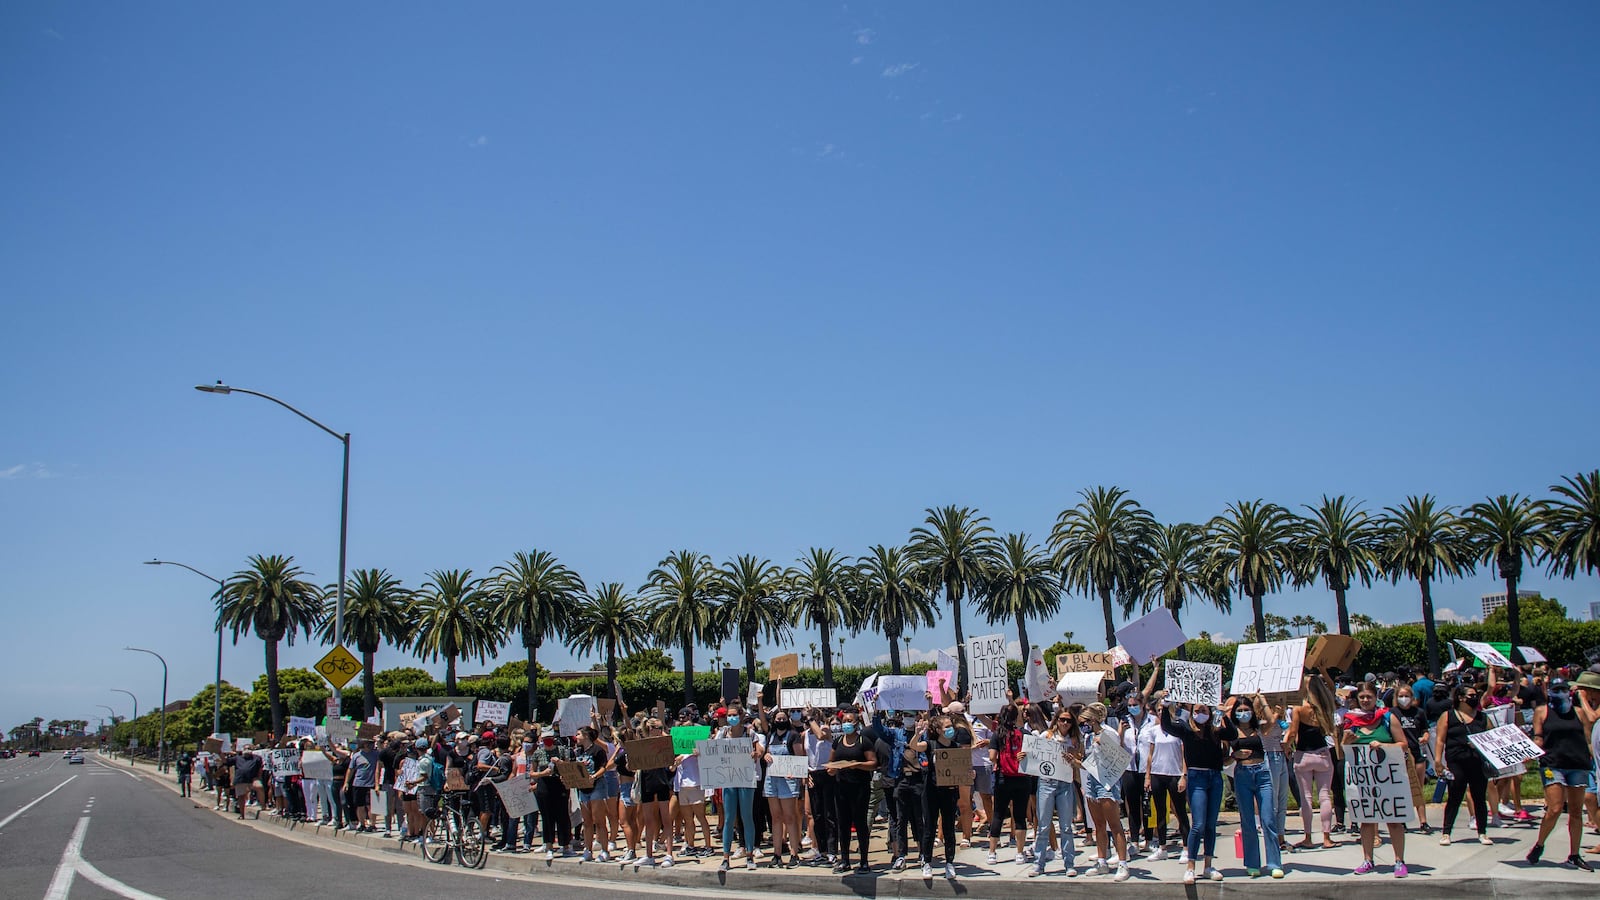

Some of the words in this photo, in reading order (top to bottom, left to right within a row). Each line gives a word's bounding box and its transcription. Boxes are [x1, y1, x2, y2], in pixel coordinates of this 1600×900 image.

[973, 639, 1005, 658] BLACK
[1073, 653, 1111, 665] BLACK
[1240, 647, 1260, 669] I
[973, 656, 1007, 679] LIVES
[1058, 664, 1089, 674] LIVES
[1175, 666, 1197, 680] SAY
[883, 679, 913, 690] Stand
[1168, 677, 1204, 693] THEIR
[1237, 666, 1303, 693] BRETHE
[782, 689, 833, 707] ENOUGH!
[971, 679, 1006, 700] MATTER
[1171, 688, 1212, 705] NAMES
[1026, 737, 1041, 750] WE
[1490, 743, 1518, 758] SILENCE
[1517, 740, 1531, 749] IS
[1031, 750, 1058, 763] WITH
[1352, 746, 1386, 766] NO
[1498, 748, 1541, 766] BETRAYAL
[702, 767, 714, 787] I
[715, 765, 754, 785] STAND
[937, 768, 951, 777] NO
[1346, 763, 1403, 786] JUSTICE
[1360, 786, 1382, 798] NO
[1350, 797, 1407, 820] PEACE
